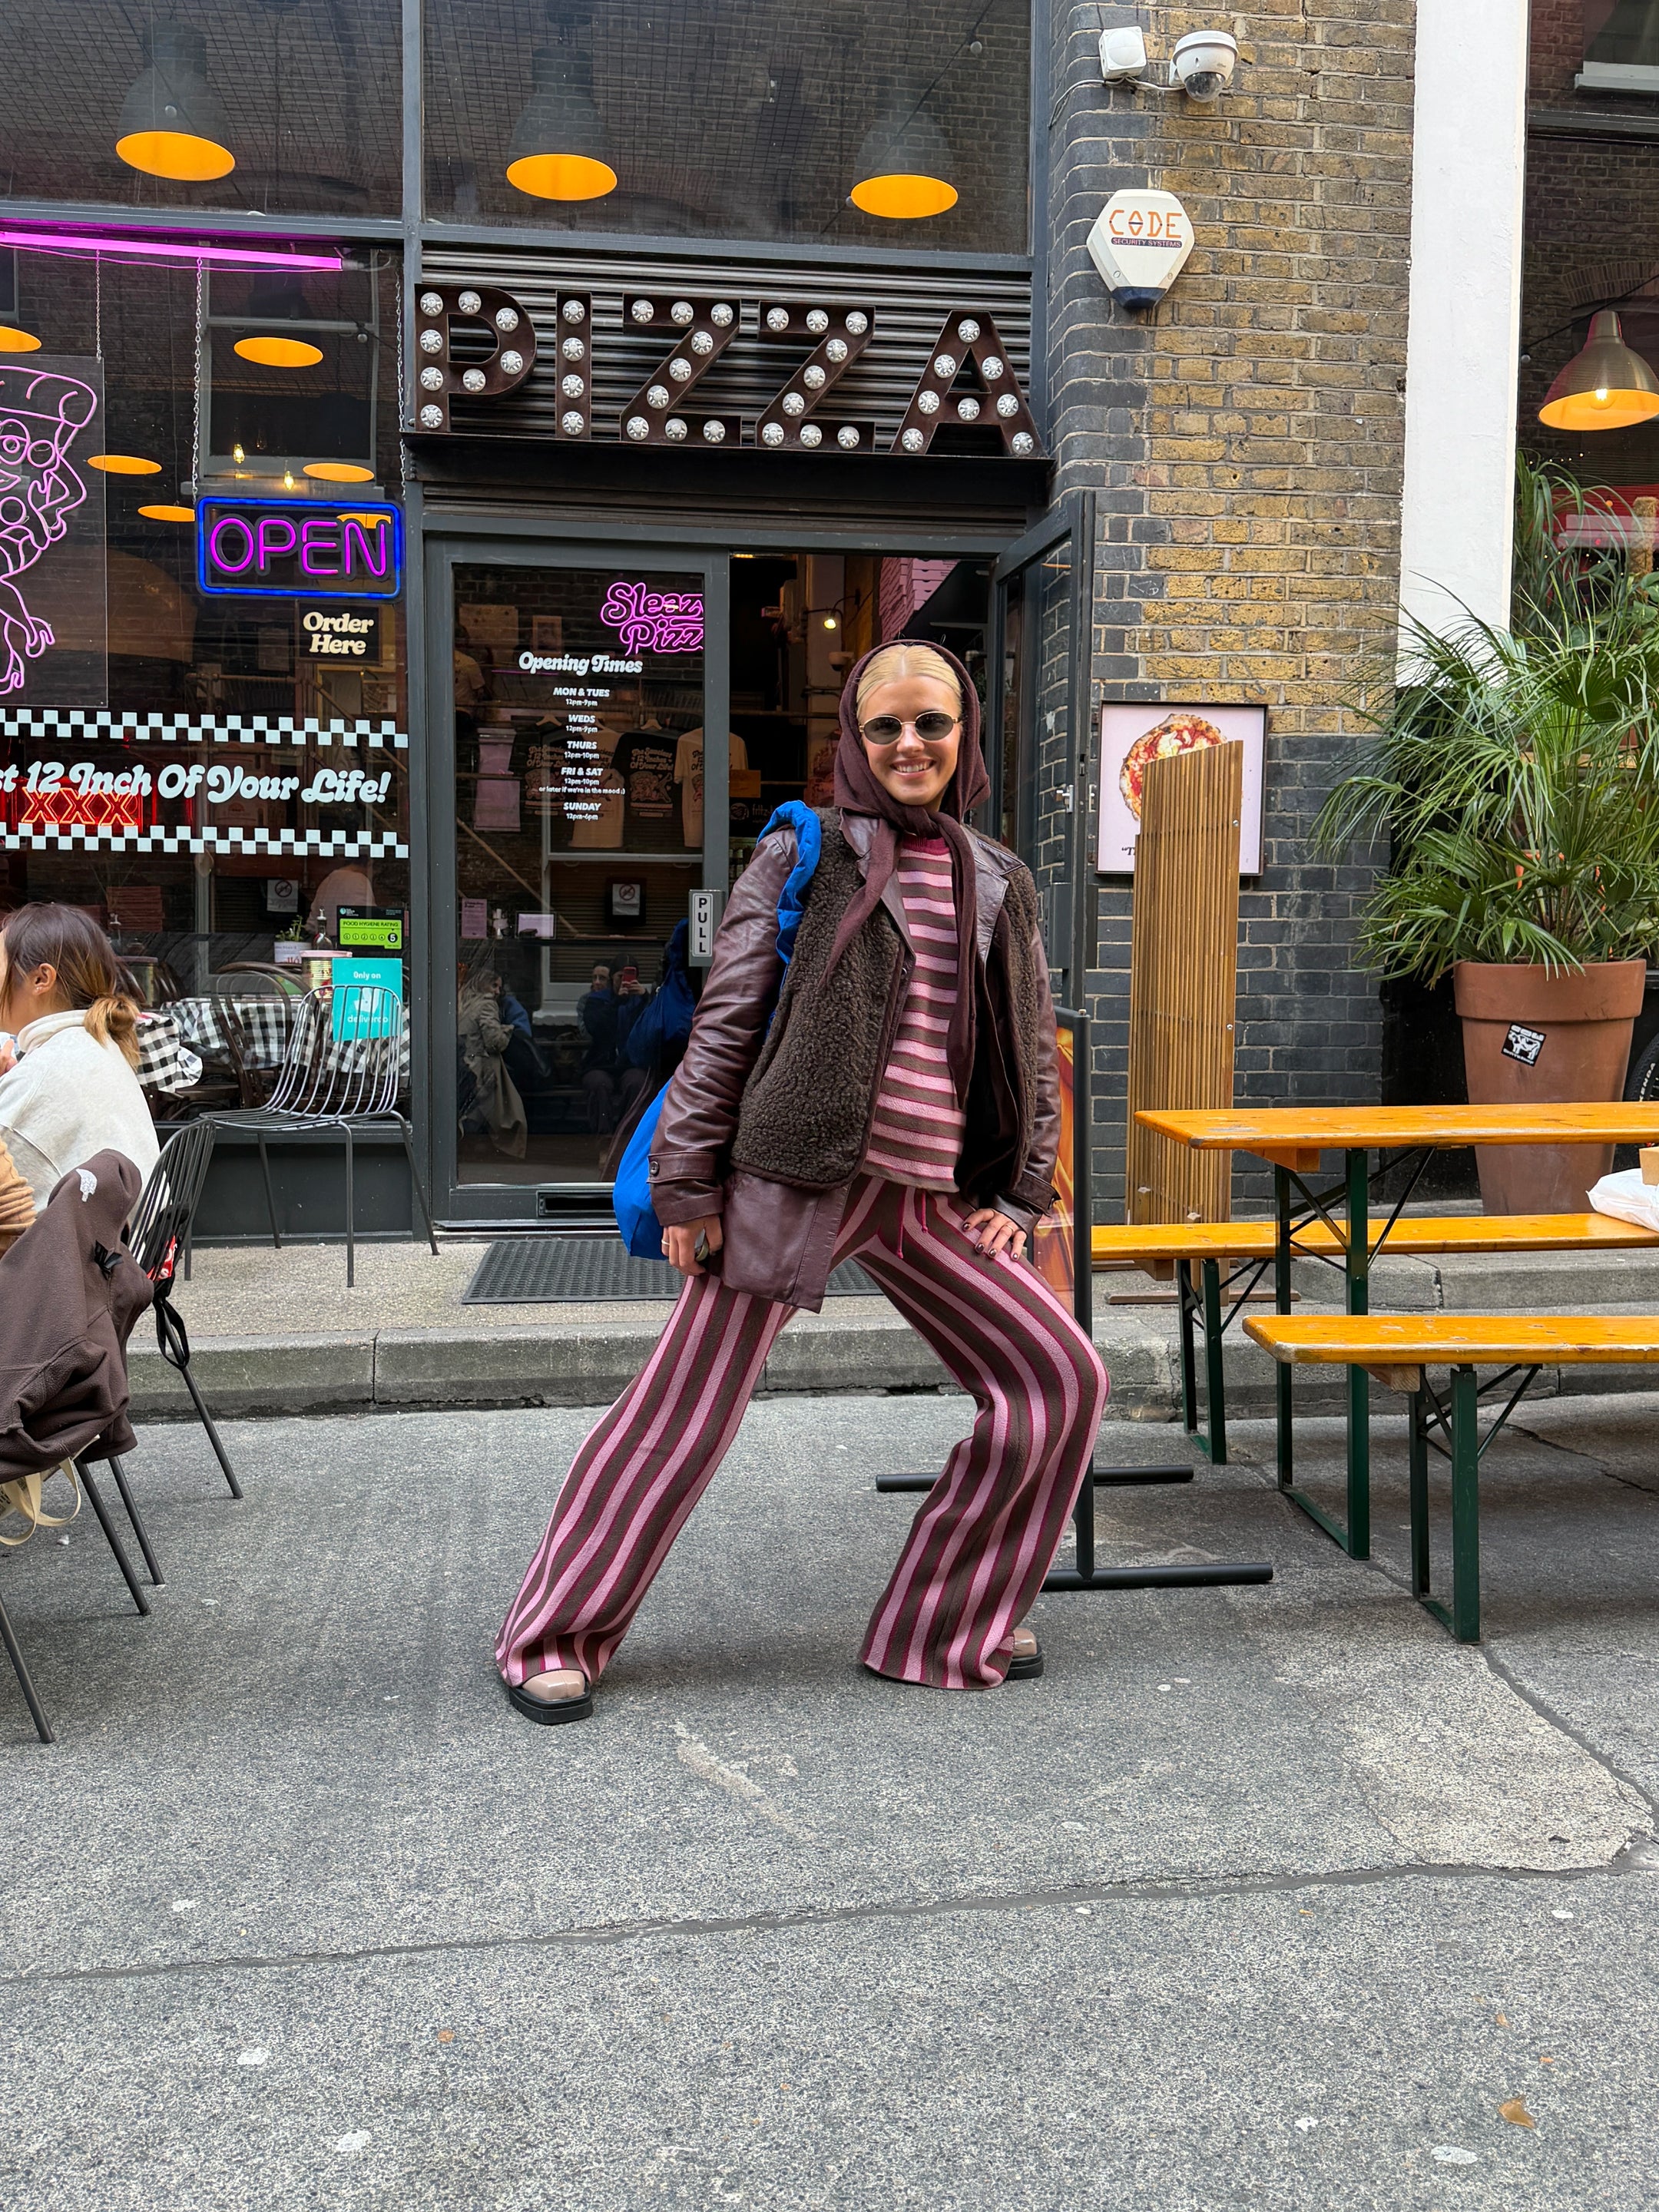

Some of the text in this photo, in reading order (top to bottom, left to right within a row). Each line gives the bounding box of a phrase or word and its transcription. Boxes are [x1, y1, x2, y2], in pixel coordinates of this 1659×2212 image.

[1109, 210, 1182, 238] CODE
[415, 283, 1047, 458] PIZZA
[210, 518, 386, 577] OPEN
[600, 581, 704, 627] Sleaz
[303, 611, 374, 634] Order
[310, 634, 366, 655] Here
[620, 619, 704, 657] Pizz
[518, 651, 644, 677] Opening Times
[553, 687, 611, 697] MON & TUES
[565, 698, 598, 707] 12pm-9pm
[565, 725, 598, 733] 12pm-9pm
[568, 714, 596, 724] WEDS
[565, 751, 600, 760] 12pm-10pm
[567, 740, 598, 750] THURS
[27, 761, 65, 793] 12
[69, 763, 152, 796] Inch
[157, 763, 206, 799] Of
[206, 765, 300, 803] Your
[301, 768, 391, 803] Life!
[561, 767, 604, 777] FRI & SAT
[21, 786, 136, 826] XXX
[563, 802, 601, 811] SUNDAY
[697, 897, 707, 953] PULL
[353, 971, 370, 981] Only
